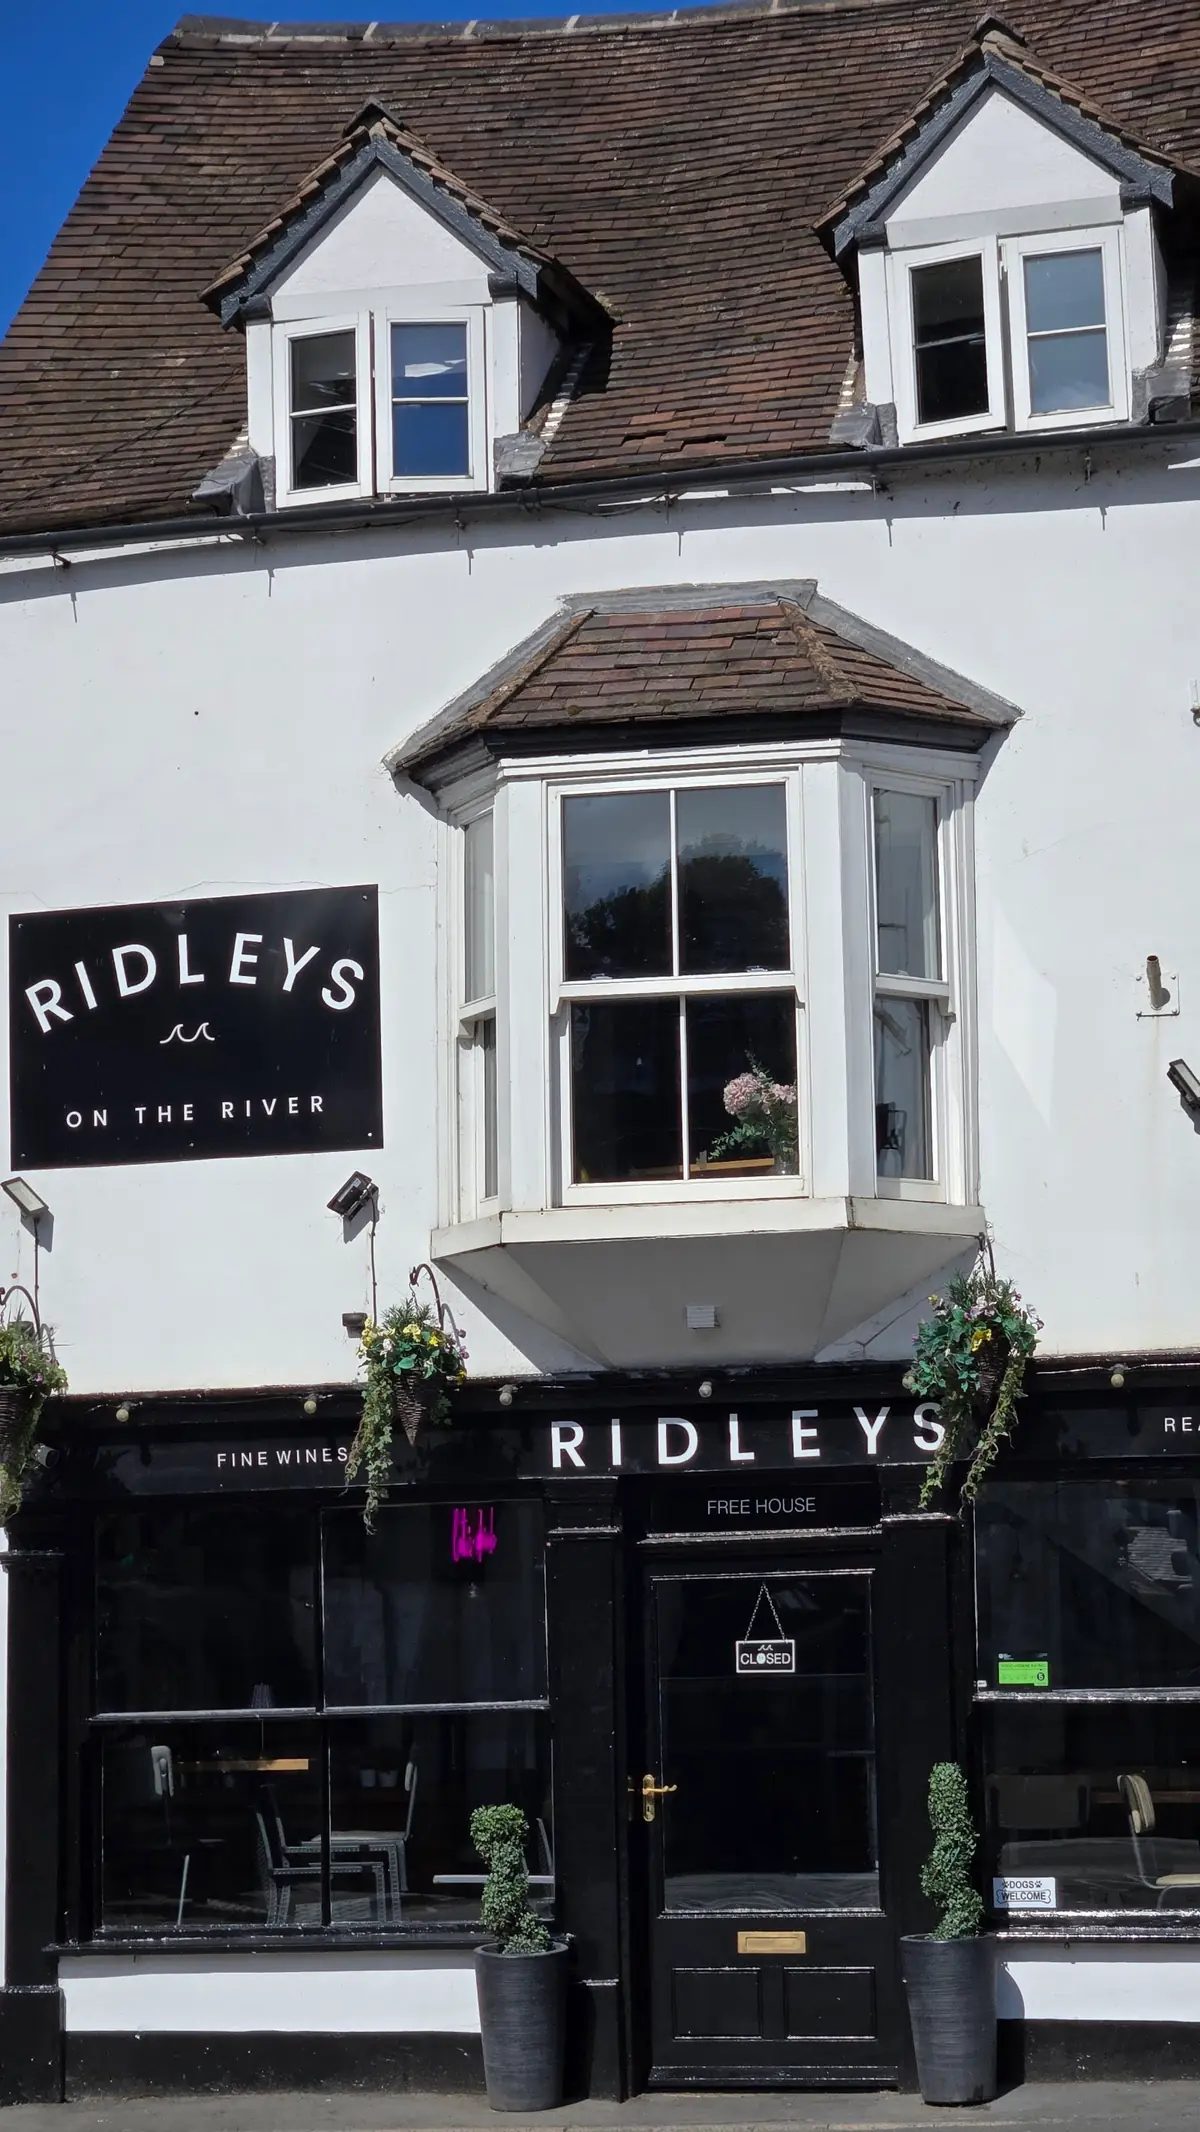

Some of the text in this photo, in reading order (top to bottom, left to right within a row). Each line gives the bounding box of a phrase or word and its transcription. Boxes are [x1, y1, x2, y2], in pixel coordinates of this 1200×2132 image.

[25, 932, 364, 1033] RIDLEYS
[66, 1095, 324, 1128] ON THE RIVER
[1164, 1416, 1200, 1432] RE
[551, 1402, 945, 1468] RIDLEYS
[217, 1447, 348, 1468] FINE WINES
[707, 1497, 817, 1515] FREE HOUSE
[740, 1652, 791, 1665] CLOSED
[1009, 1880, 1035, 1889] DOGS
[1002, 1891, 1046, 1901] WELCOME
